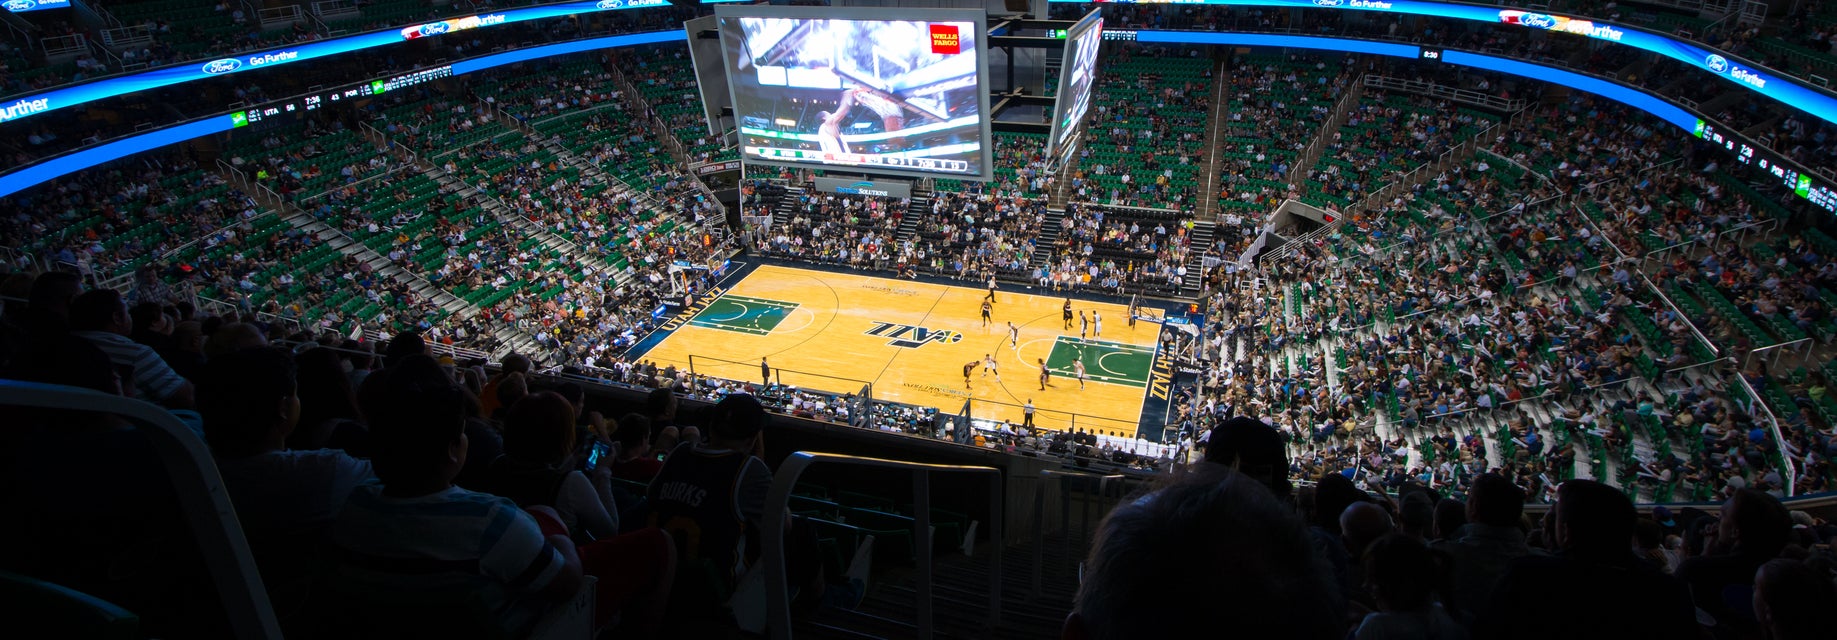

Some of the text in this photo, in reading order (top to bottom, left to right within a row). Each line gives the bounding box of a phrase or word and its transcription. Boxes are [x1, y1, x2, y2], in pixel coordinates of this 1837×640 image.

[1362, 0, 1393, 9] Further
[250, 56, 264, 66] Go
[264, 51, 298, 64] Further
[1731, 66, 1741, 78] Go
[1741, 70, 1766, 88] Further
[0, 97, 48, 119] urther
[264, 107, 279, 116] UTA
[344, 89, 358, 98] POR
[661, 286, 728, 331] UTAH JAZZ
[1150, 369, 1173, 401] JAZZ
[659, 481, 708, 508] BURKS
